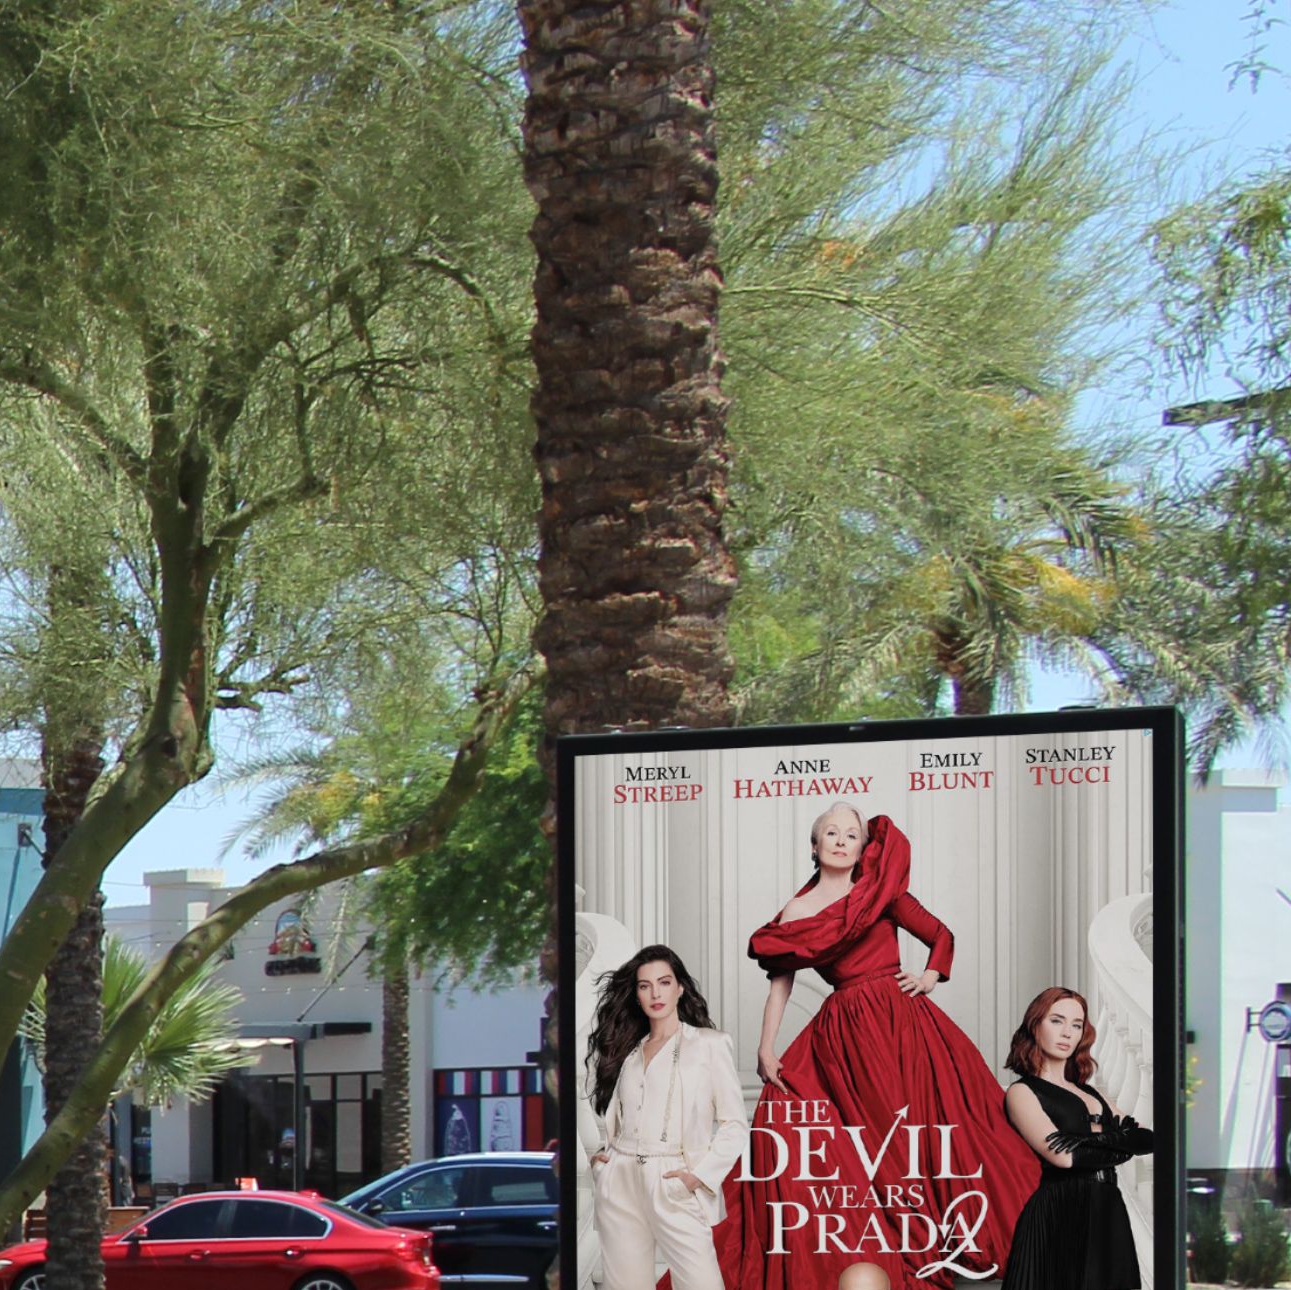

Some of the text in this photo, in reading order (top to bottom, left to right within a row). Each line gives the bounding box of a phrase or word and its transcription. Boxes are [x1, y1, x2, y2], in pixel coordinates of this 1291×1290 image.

[919, 752, 983, 768] EMILY
[1025, 746, 1117, 763] STANLEY
[625, 765, 691, 782] MERYL
[775, 759, 830, 775] ANNE
[1029, 765, 1112, 786] TUCCI
[733, 776, 874, 799] HATHAWAY
[908, 770, 995, 791] BLUNT
[613, 783, 704, 804] STREEP
[760, 1099, 831, 1124] THE
[733, 1103, 983, 1182] DEVIL
[806, 1184, 925, 1209] WEARS
[766, 1190, 999, 1280] PRADA 2
